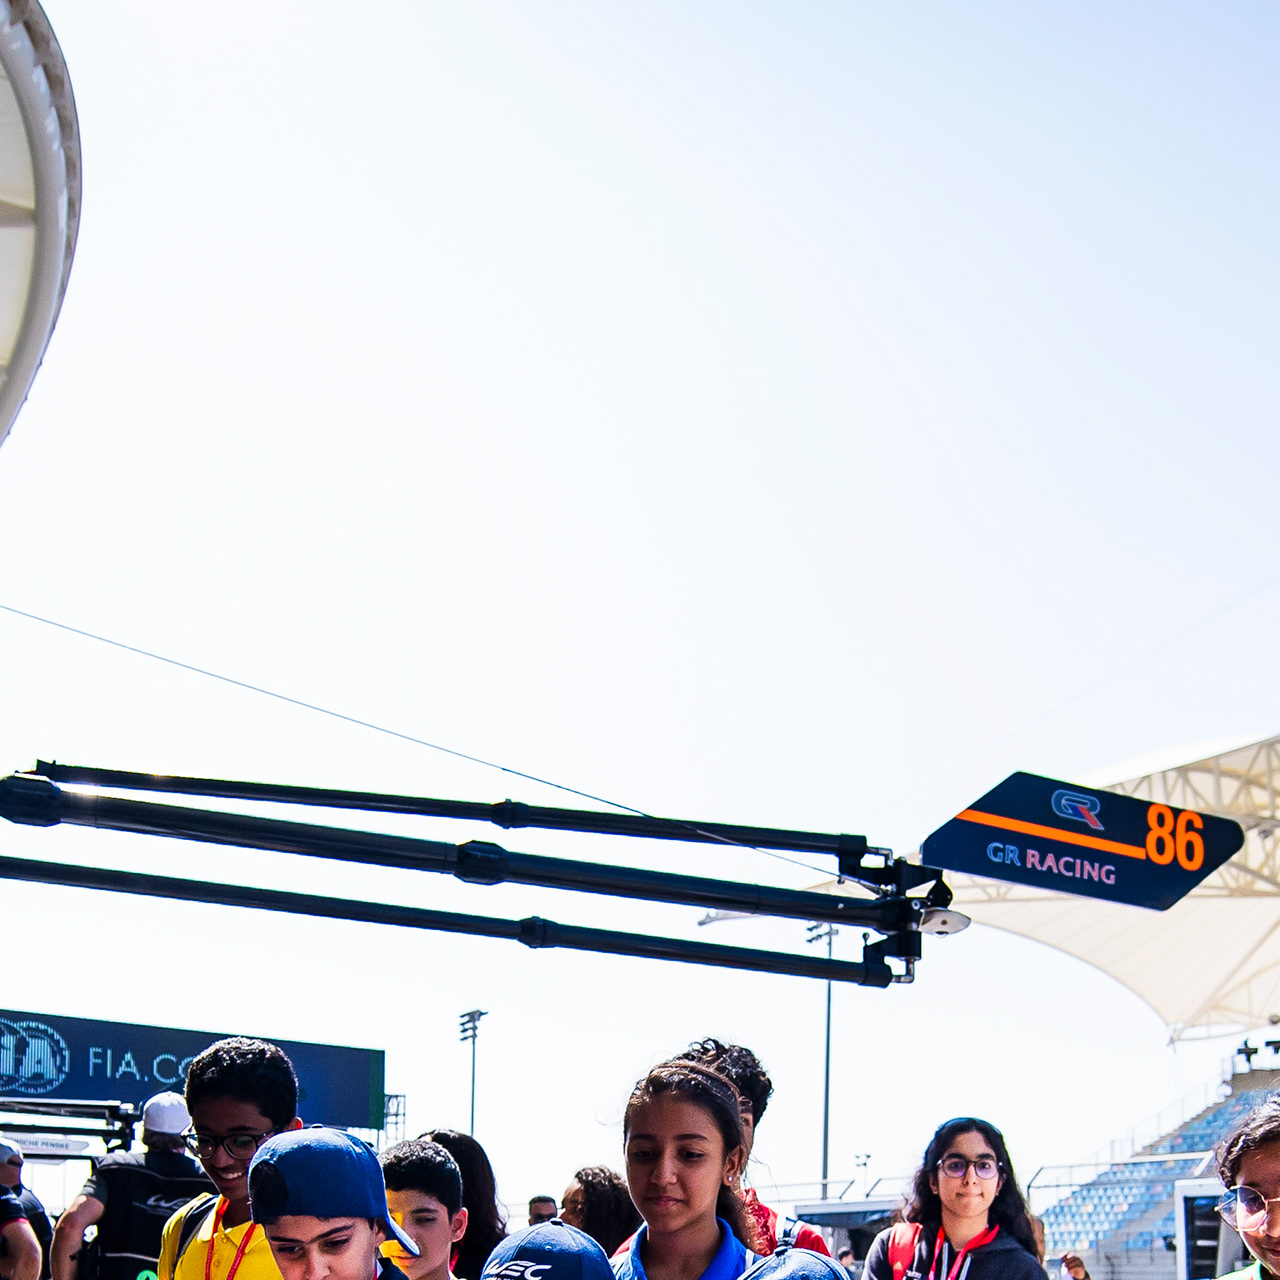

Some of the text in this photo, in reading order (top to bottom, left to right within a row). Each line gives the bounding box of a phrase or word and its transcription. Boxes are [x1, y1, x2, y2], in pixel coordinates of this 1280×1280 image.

[986, 842, 1117, 886] GR RACING
[1145, 803, 1205, 872] 86
